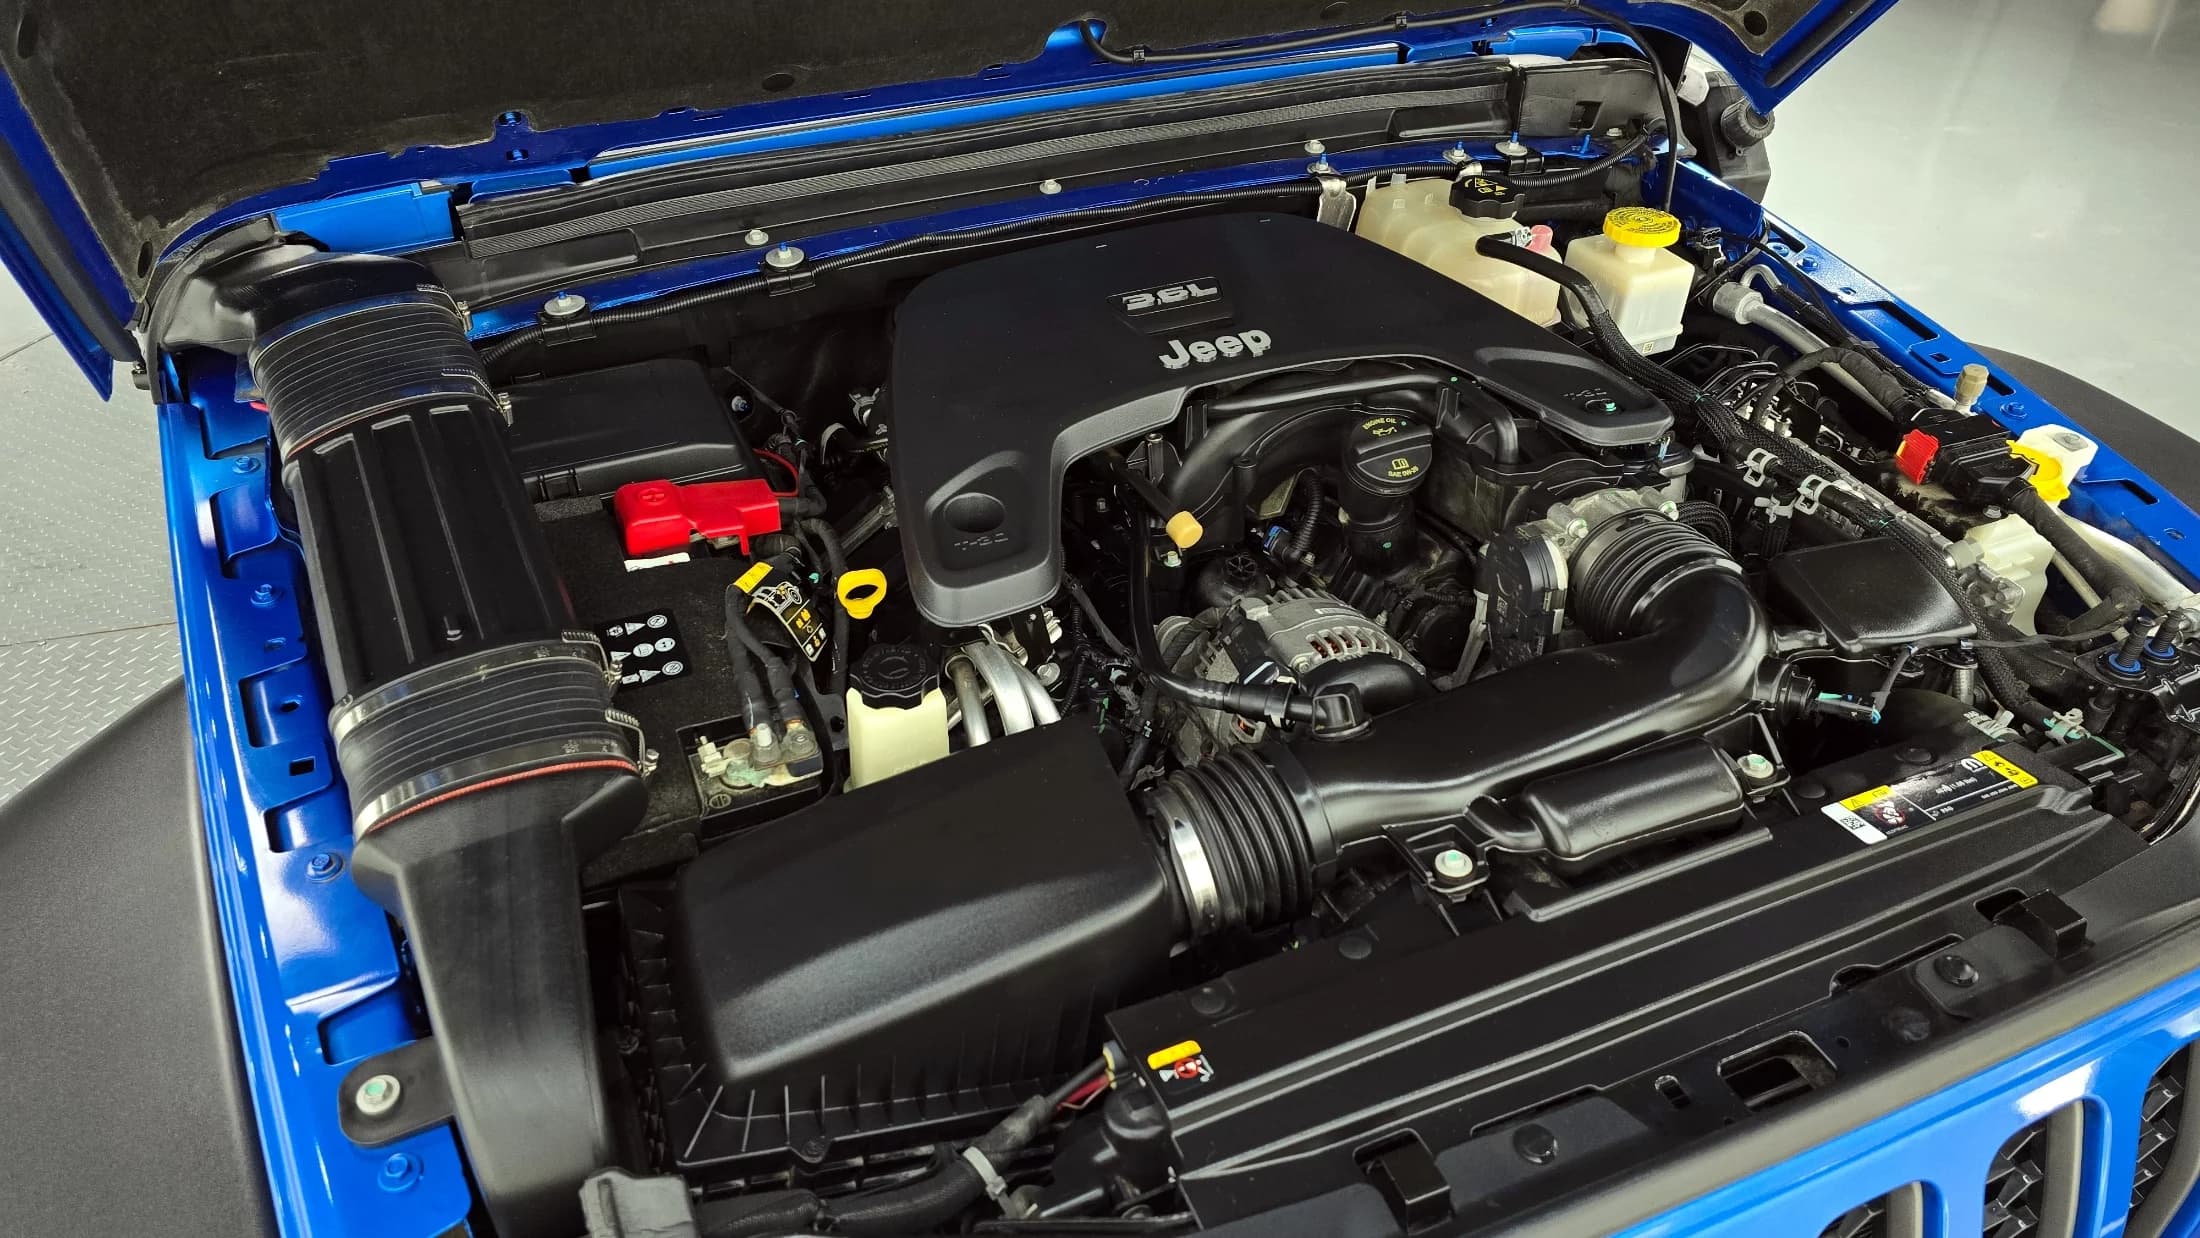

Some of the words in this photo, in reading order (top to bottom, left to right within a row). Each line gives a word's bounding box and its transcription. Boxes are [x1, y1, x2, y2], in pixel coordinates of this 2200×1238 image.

[1122, 284, 1218, 311] 3.6L
[1158, 330, 1272, 370] Jeep
[1362, 417, 1385, 430] ENGINE
